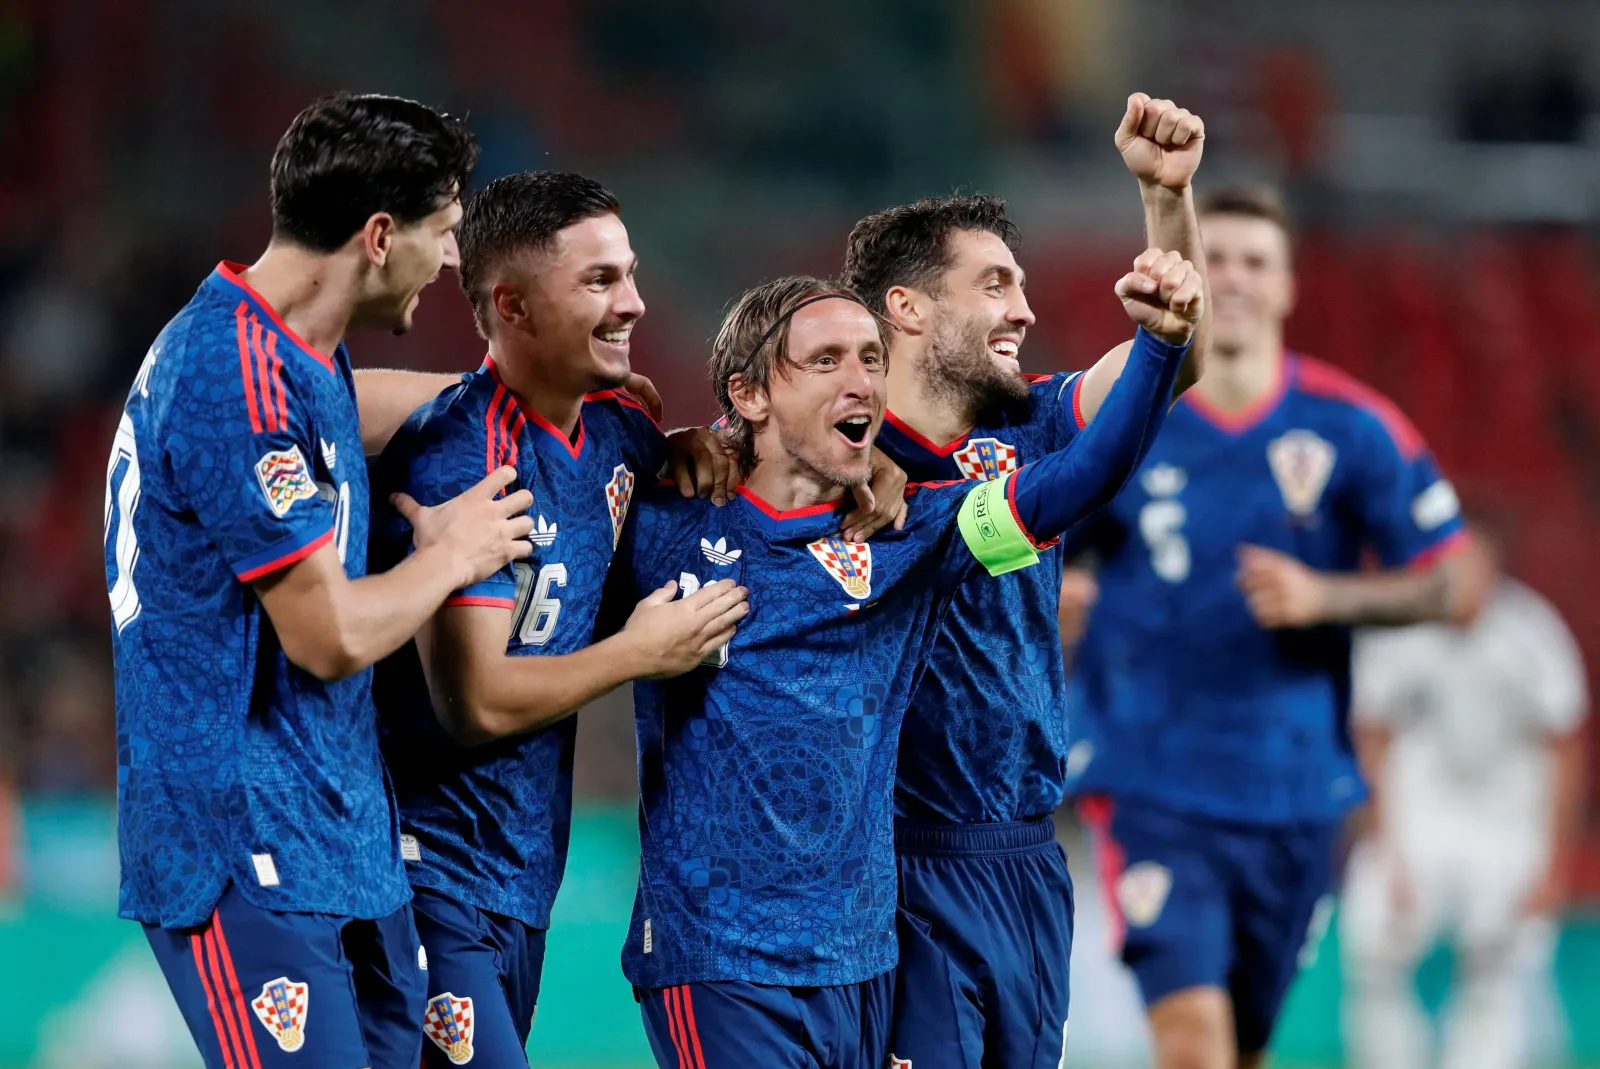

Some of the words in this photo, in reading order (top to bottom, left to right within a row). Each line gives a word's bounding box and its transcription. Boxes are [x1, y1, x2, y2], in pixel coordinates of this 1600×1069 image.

[980, 445, 996, 481] HNS
[832, 540, 852, 570] HNS
[438, 1002, 457, 1037] HNS
